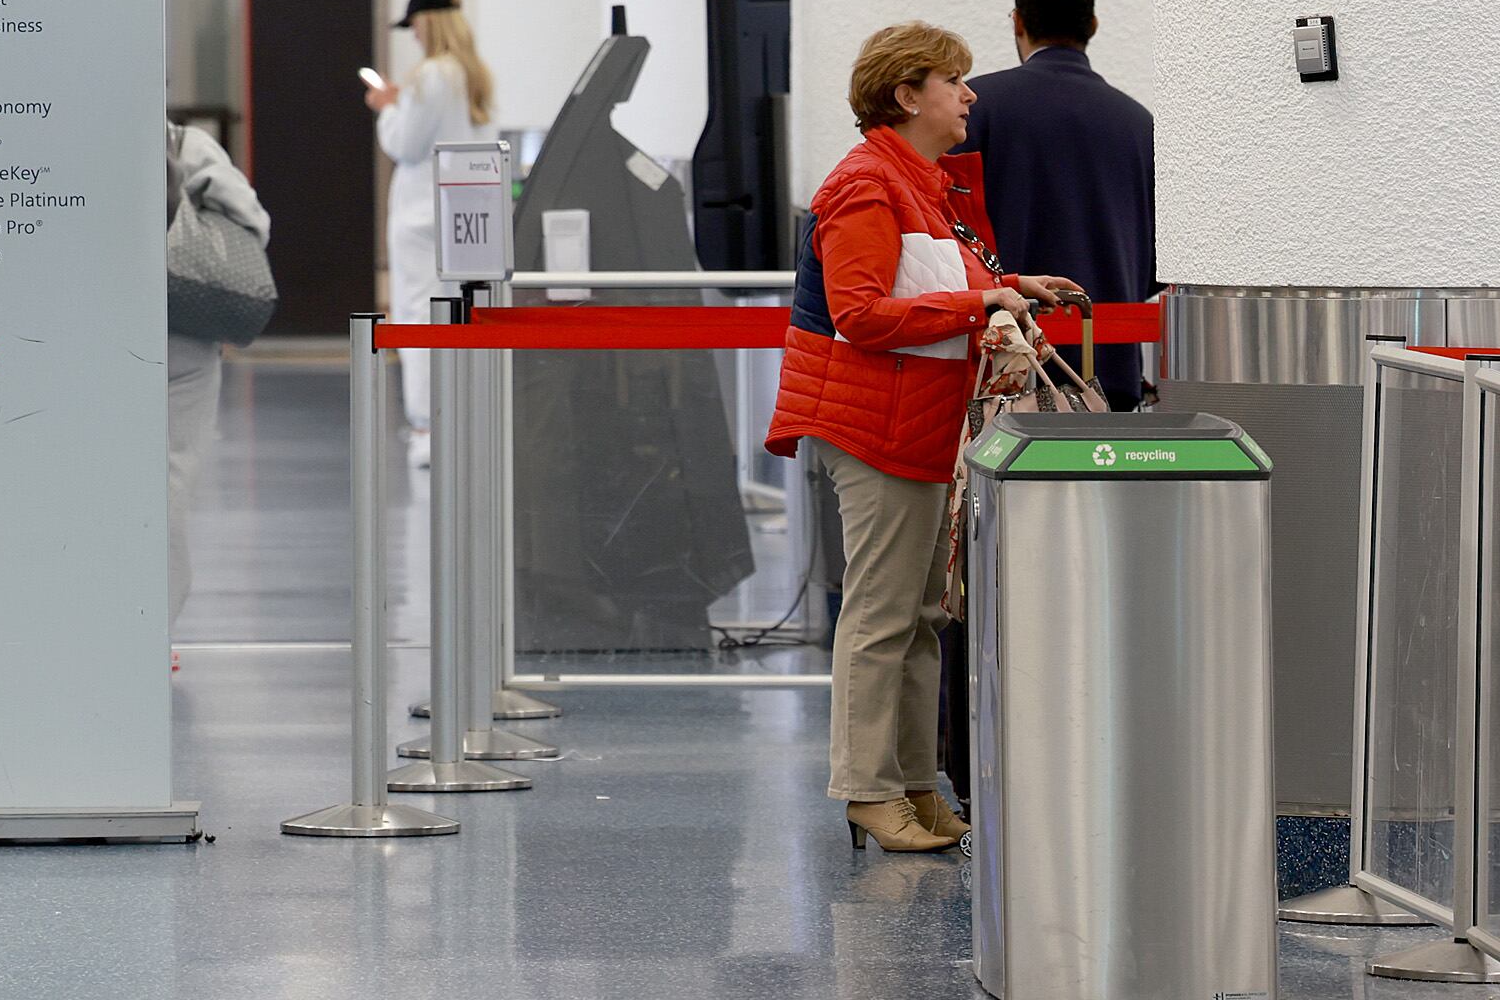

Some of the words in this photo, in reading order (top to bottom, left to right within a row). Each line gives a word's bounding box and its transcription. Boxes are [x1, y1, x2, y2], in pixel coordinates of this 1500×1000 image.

[11, 192, 85, 207] Platinum
[454, 212, 489, 244] EXIT
[1125, 449, 1176, 462] recycling
